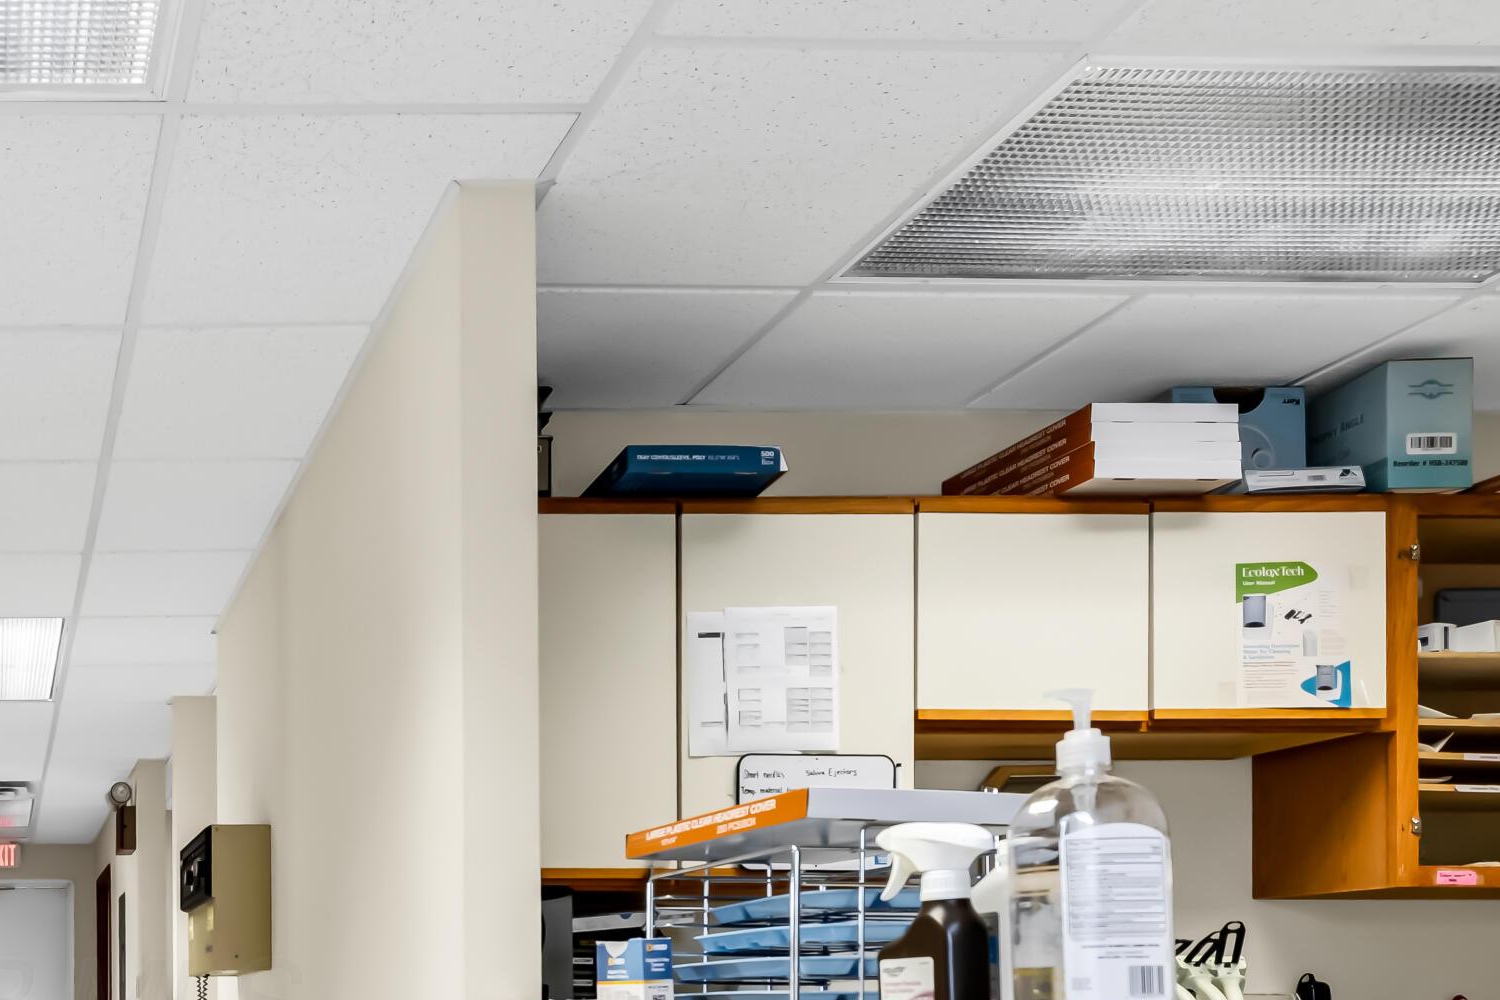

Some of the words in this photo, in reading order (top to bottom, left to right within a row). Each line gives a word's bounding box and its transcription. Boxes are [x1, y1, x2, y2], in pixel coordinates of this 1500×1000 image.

[1046, 438, 1067, 453] COVER
[760, 450, 775, 458] 500
[1049, 456, 1070, 470] COVER
[749, 798, 777, 815] COVER
